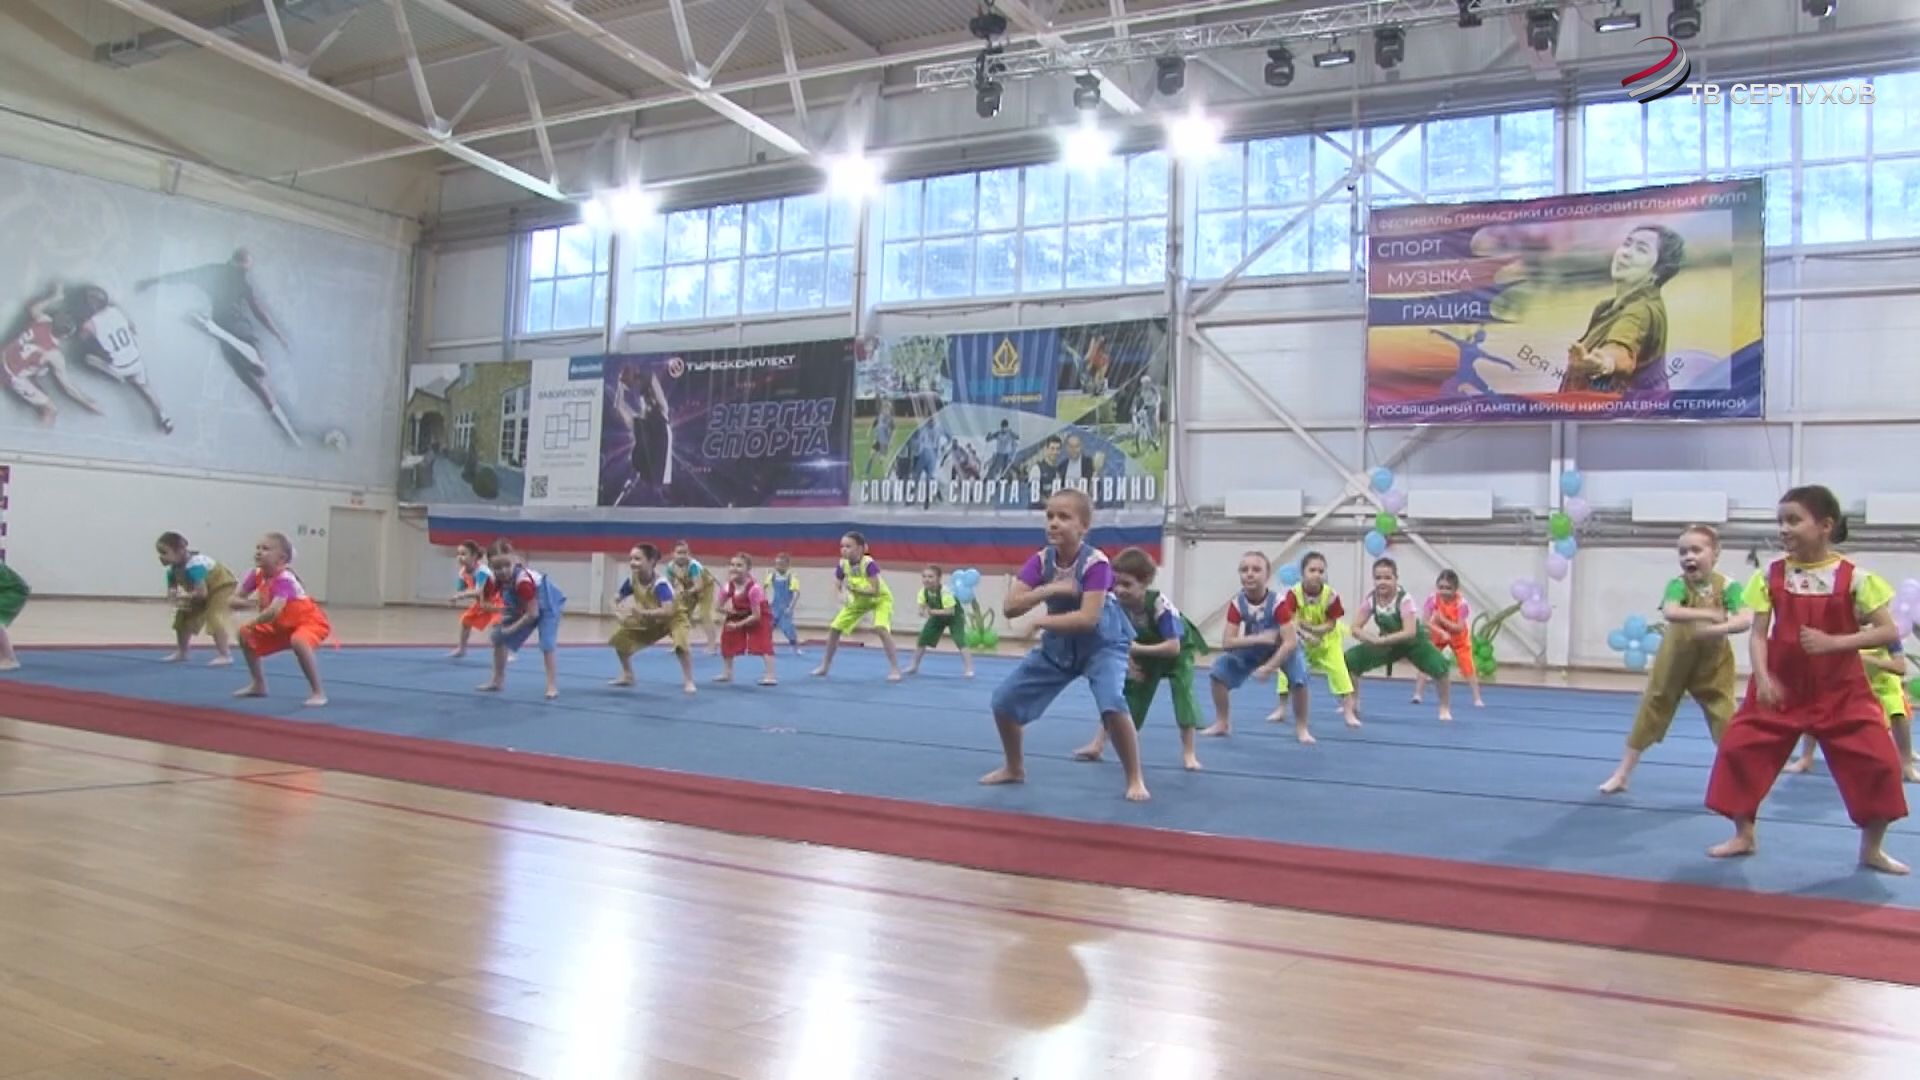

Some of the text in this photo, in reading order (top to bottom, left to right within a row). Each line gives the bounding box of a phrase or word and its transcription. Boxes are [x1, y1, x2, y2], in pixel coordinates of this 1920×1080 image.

[1378, 191, 1748, 231] ФЕСТИВАЛЬ ГИМНАСТИКИ И ОЗДОРОВИТЕЛЬНЫХ ГРУПП
[1377, 239, 1442, 258] СПОРТ
[1387, 268, 1473, 289] МУЗЫКА
[1402, 301, 1481, 320] ГРАЦИЯ
[107, 327, 131, 352] 10
[1516, 344, 1550, 373] Вся
[708, 397, 837, 431] ЭНЕРГИЯ
[1376, 397, 1747, 417] ПОСВЯЩЕННЫЙ ПАМЯТИ ИРИНЫ НИКОЛАЕВНЫ СТЕПИНОЙ
[702, 426, 830, 458] СПОРТА
[860, 479, 938, 503] СПОНСОР
[950, 479, 1020, 504] СПОРТА
[1031, 479, 1041, 503] В
